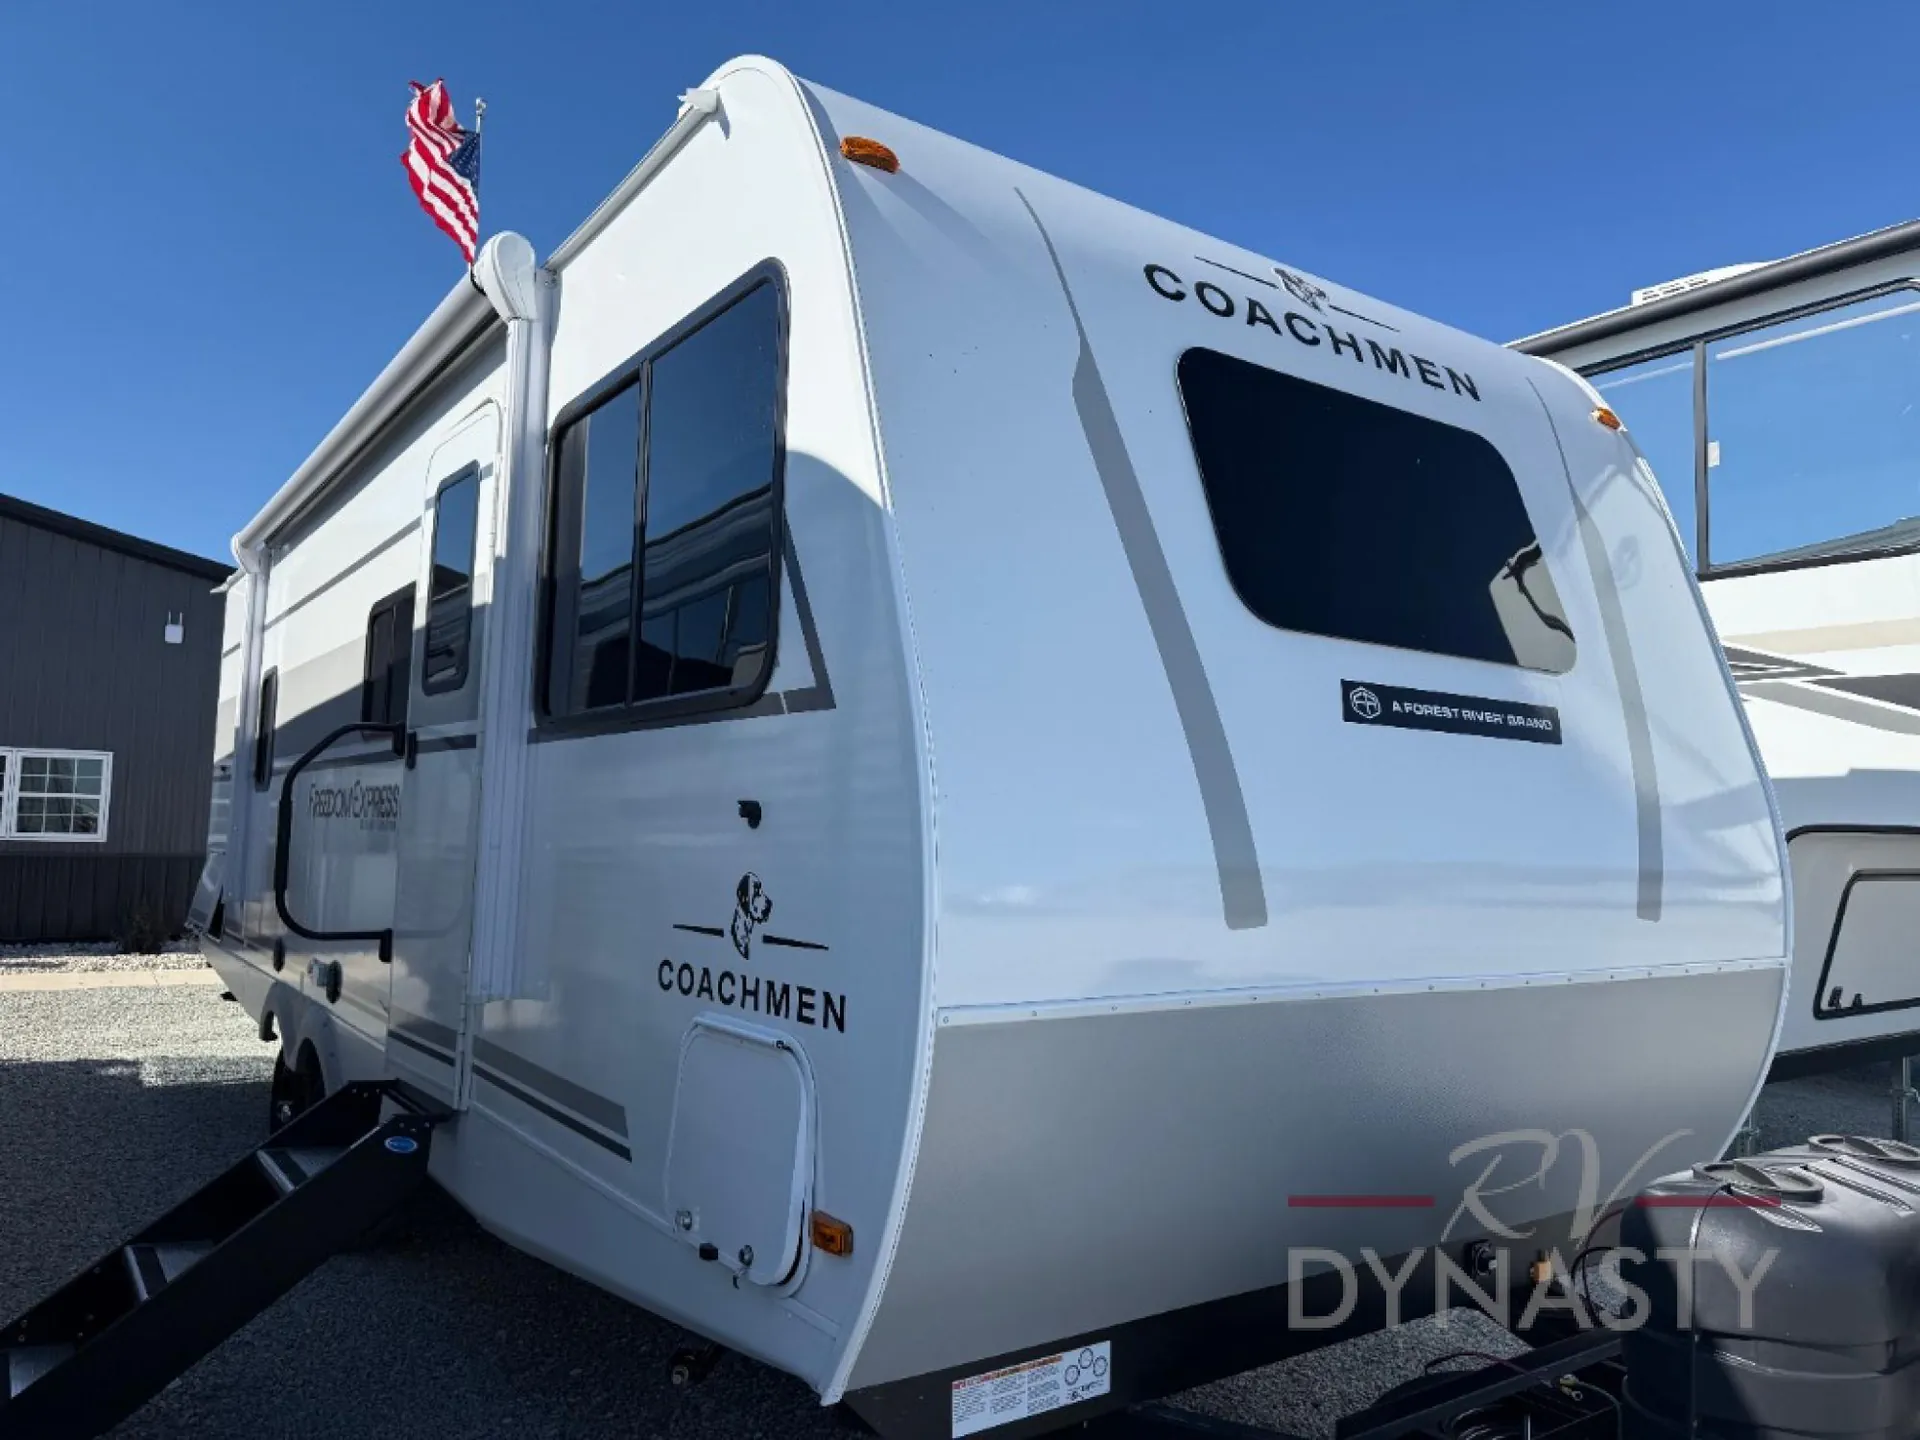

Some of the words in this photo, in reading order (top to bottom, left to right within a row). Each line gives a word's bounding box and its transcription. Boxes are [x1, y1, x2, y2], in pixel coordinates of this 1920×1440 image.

[1143, 263, 1482, 402] COACHMEN
[1392, 700, 1403, 713] A
[1405, 703, 1459, 719] FOREST
[1462, 709, 1503, 725] RIVER
[1507, 716, 1553, 731] BRAND
[657, 959, 847, 1034] COACHMEN
